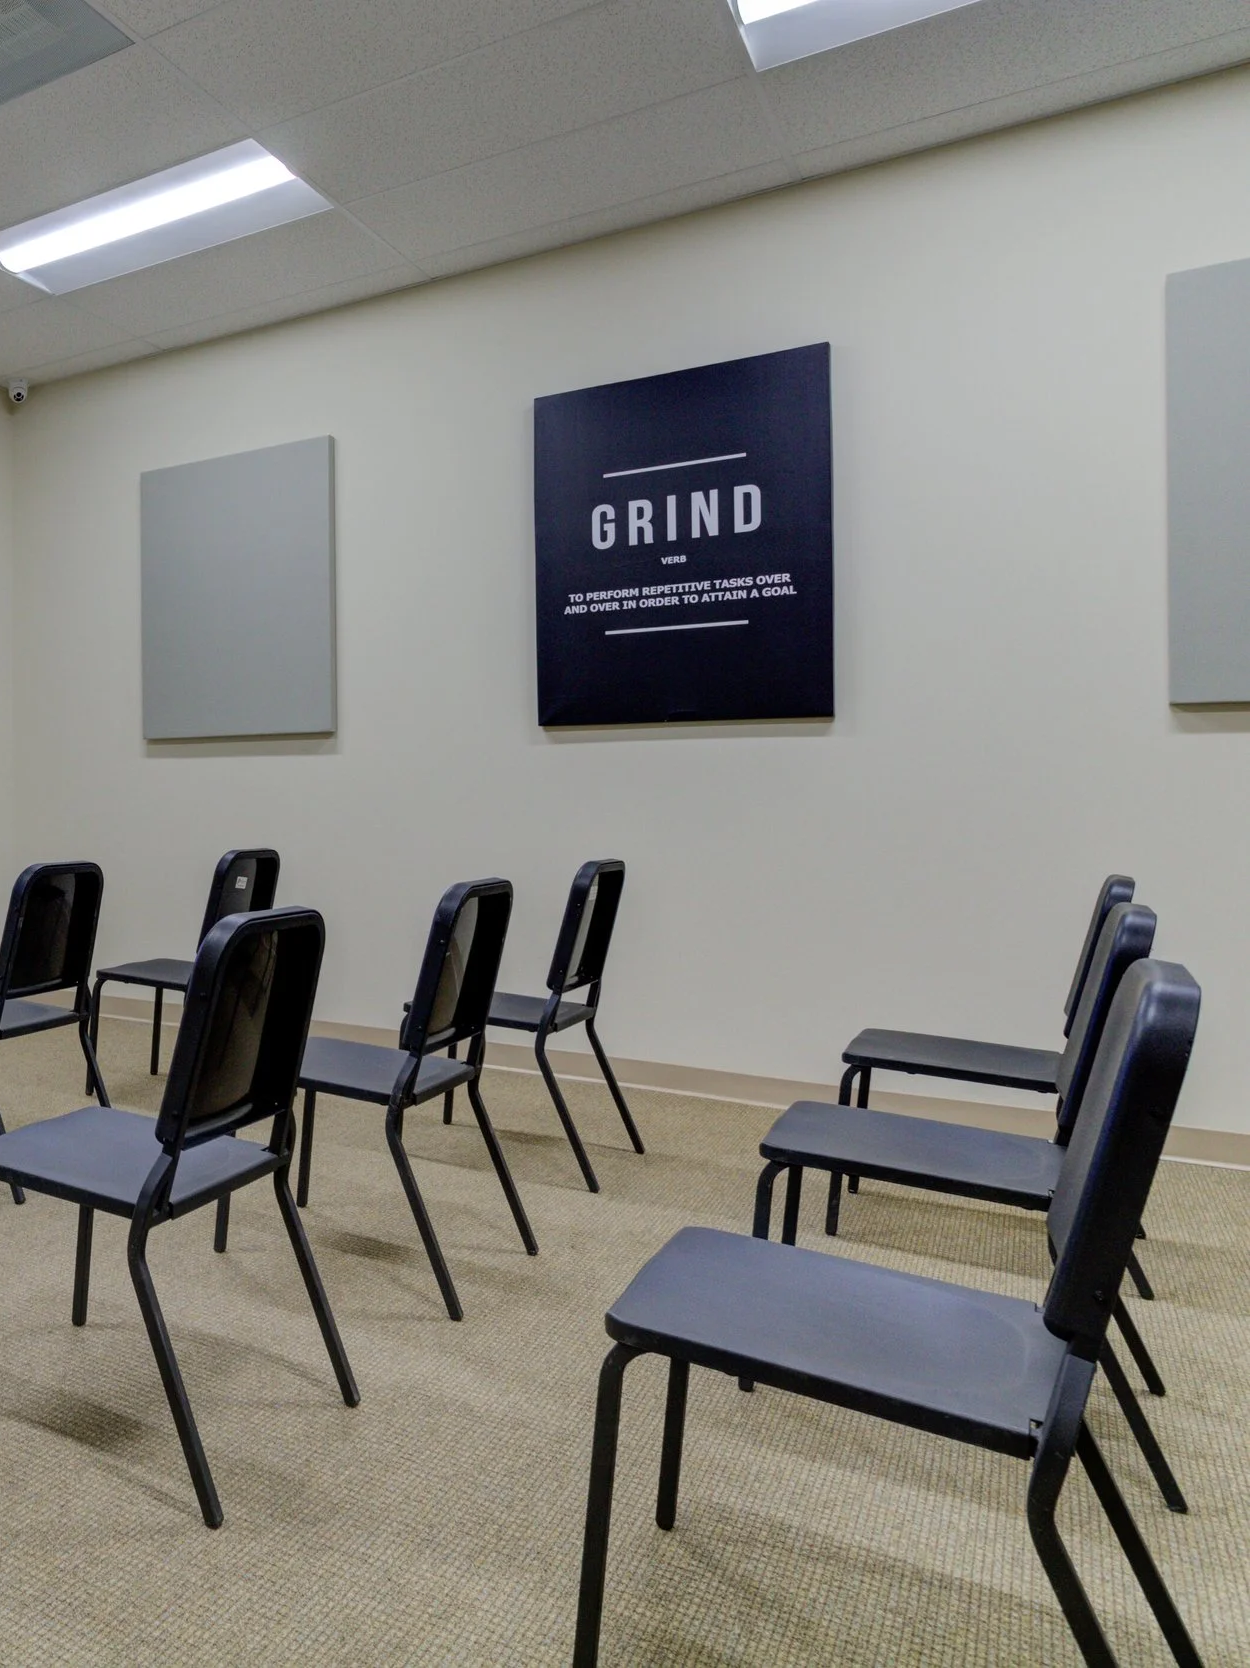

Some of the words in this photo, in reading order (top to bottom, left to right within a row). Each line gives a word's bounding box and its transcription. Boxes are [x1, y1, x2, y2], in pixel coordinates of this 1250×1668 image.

[591, 483, 762, 550] GRIND
[660, 555, 687, 565] VERB
[563, 604, 588, 615] AND
[589, 601, 620, 613] OVER
[622, 600, 637, 610] IN
[638, 596, 680, 608] ORDER
[682, 594, 699, 604] TO
[701, 590, 747, 603] ATTAIN
[749, 588, 760, 599] A
[761, 585, 797, 597] GOAL
[568, 593, 584, 603] TO
[586, 587, 639, 602] PERFORM
[642, 581, 711, 596] REPETITIVE
[713, 576, 754, 590] TASKS
[755, 573, 792, 585] OVER
